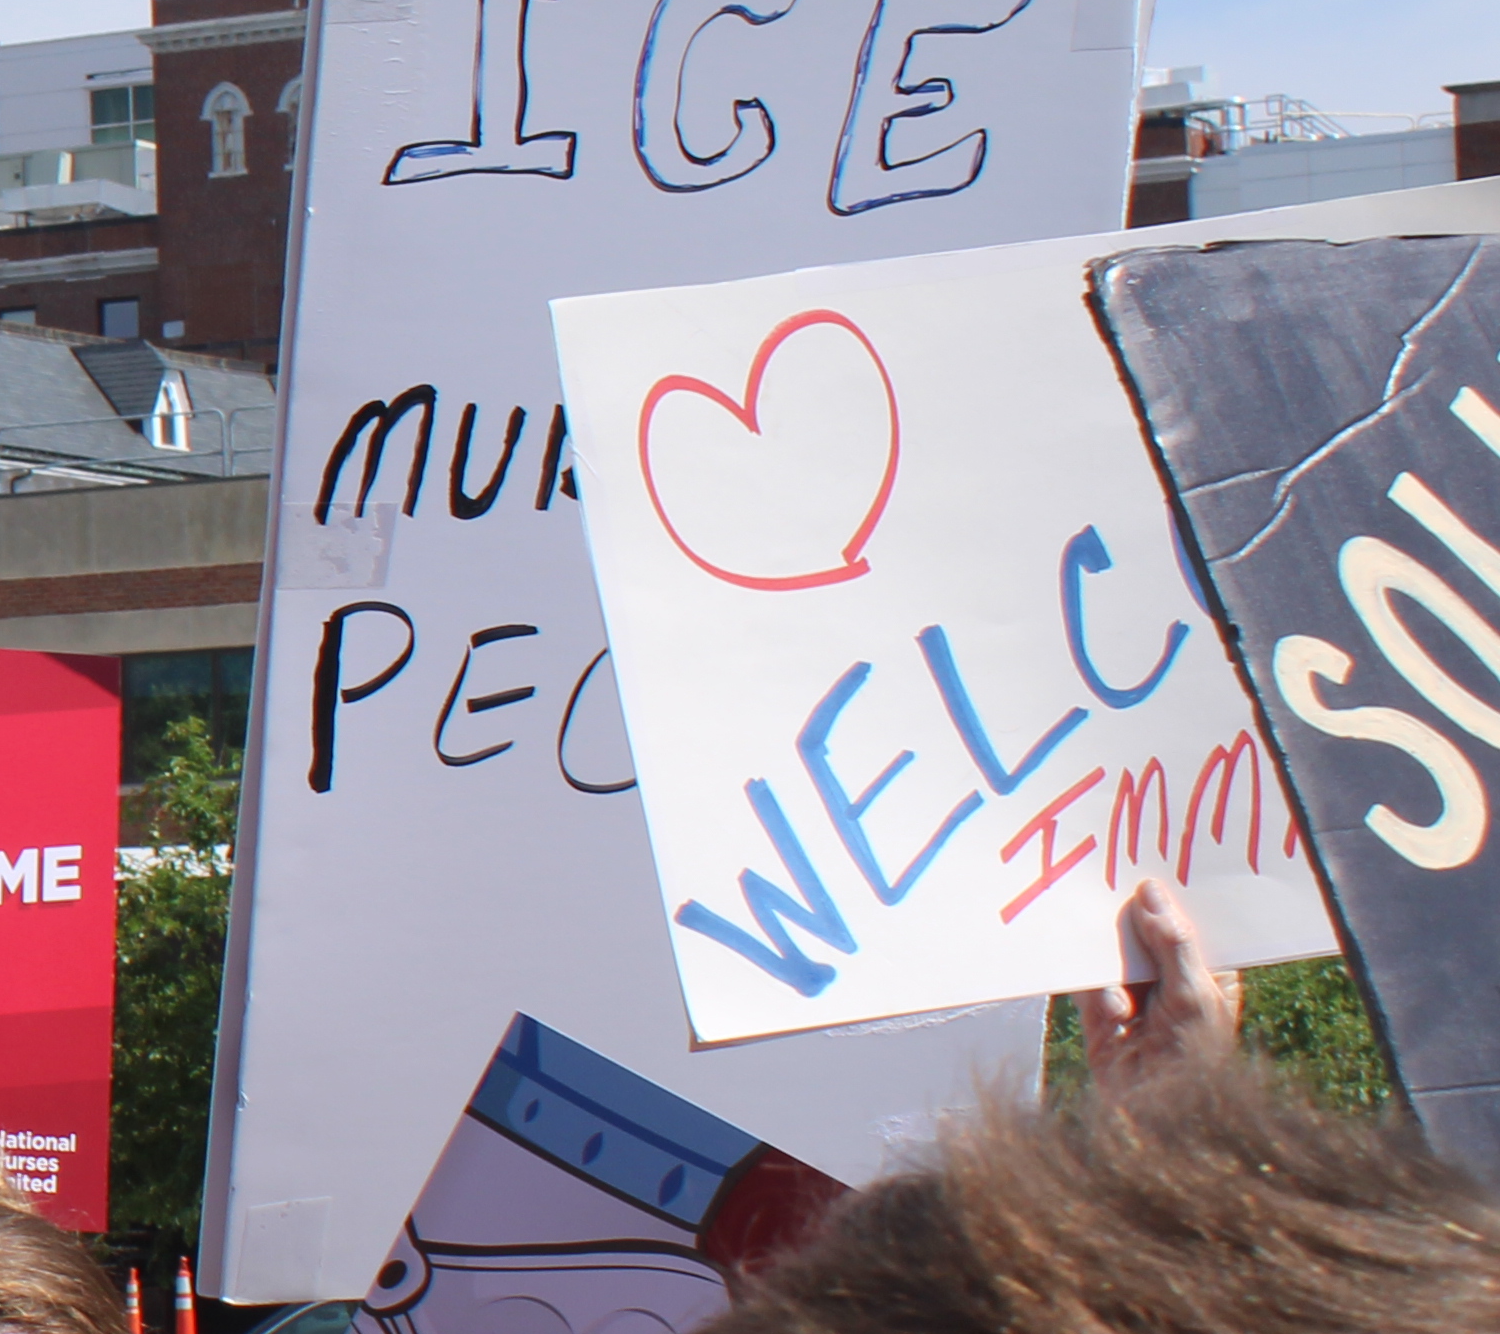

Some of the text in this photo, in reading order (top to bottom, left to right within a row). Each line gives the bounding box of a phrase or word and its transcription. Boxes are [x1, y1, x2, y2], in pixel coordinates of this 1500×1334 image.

[675, 500, 1210, 999] WELC
[999, 728, 1303, 926] IMM
[9, 1172, 58, 1194] ited
